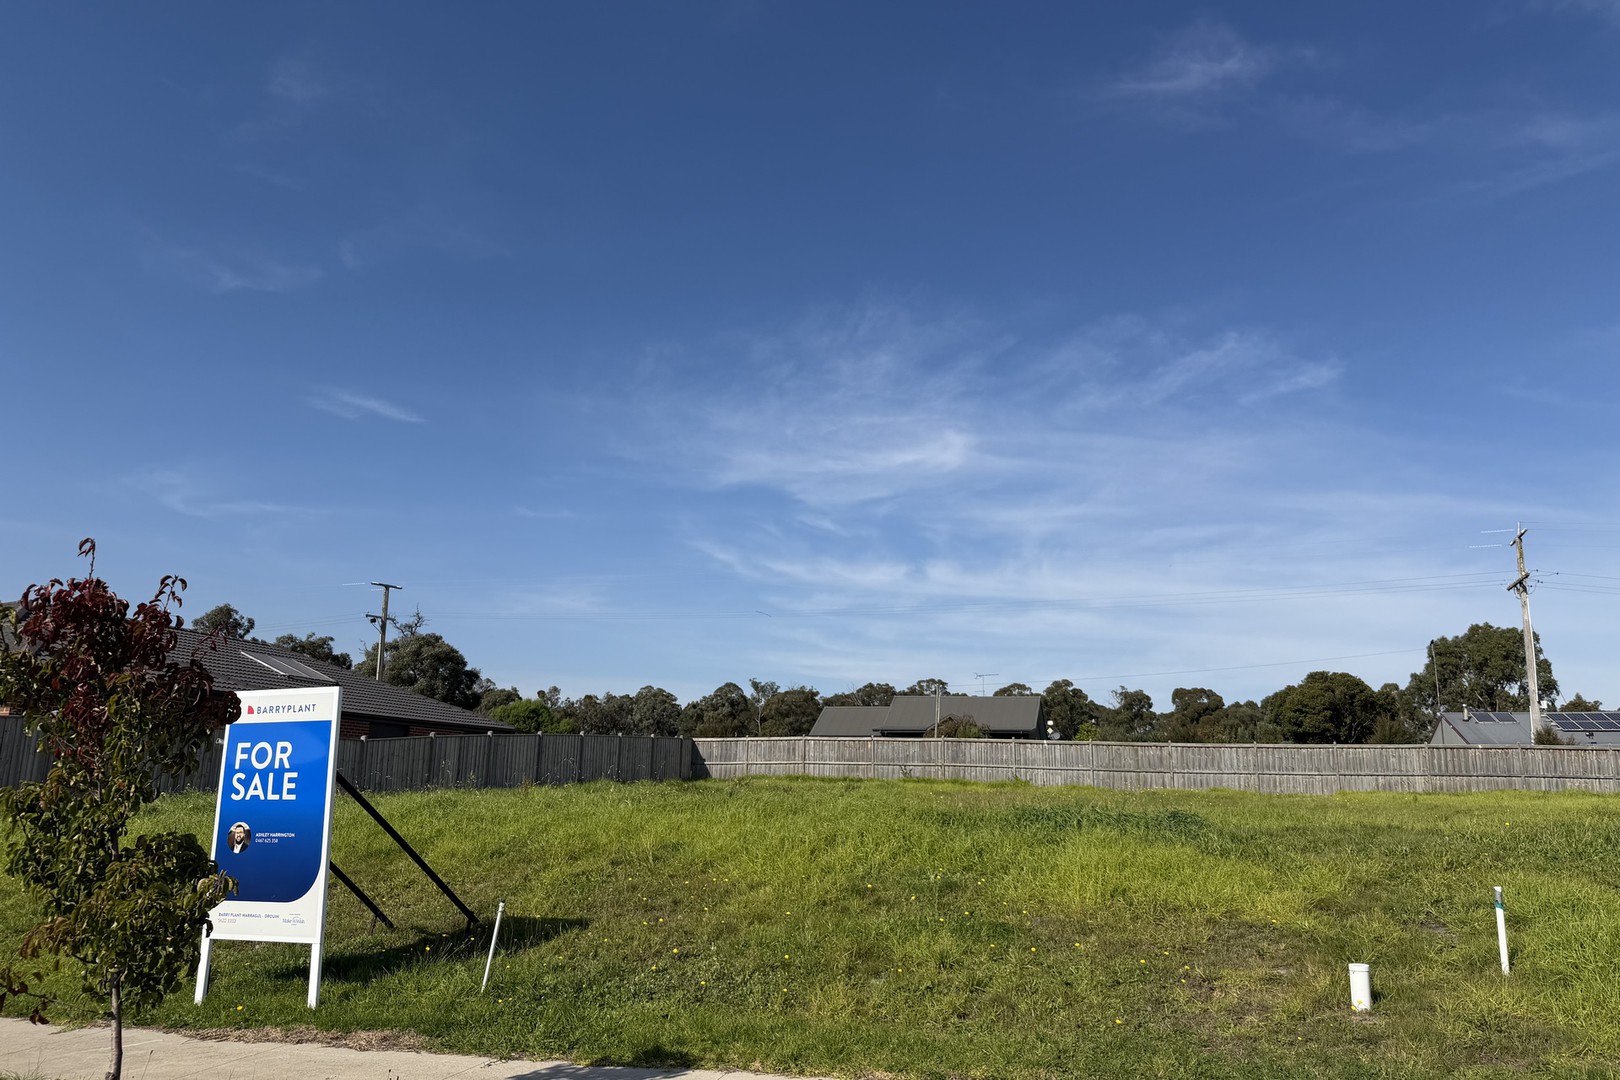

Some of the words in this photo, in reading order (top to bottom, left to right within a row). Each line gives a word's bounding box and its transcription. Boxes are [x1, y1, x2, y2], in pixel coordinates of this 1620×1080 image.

[256, 703, 317, 715] BARRYPLANT
[234, 741, 293, 770] FOR
[230, 771, 299, 801] SALE
